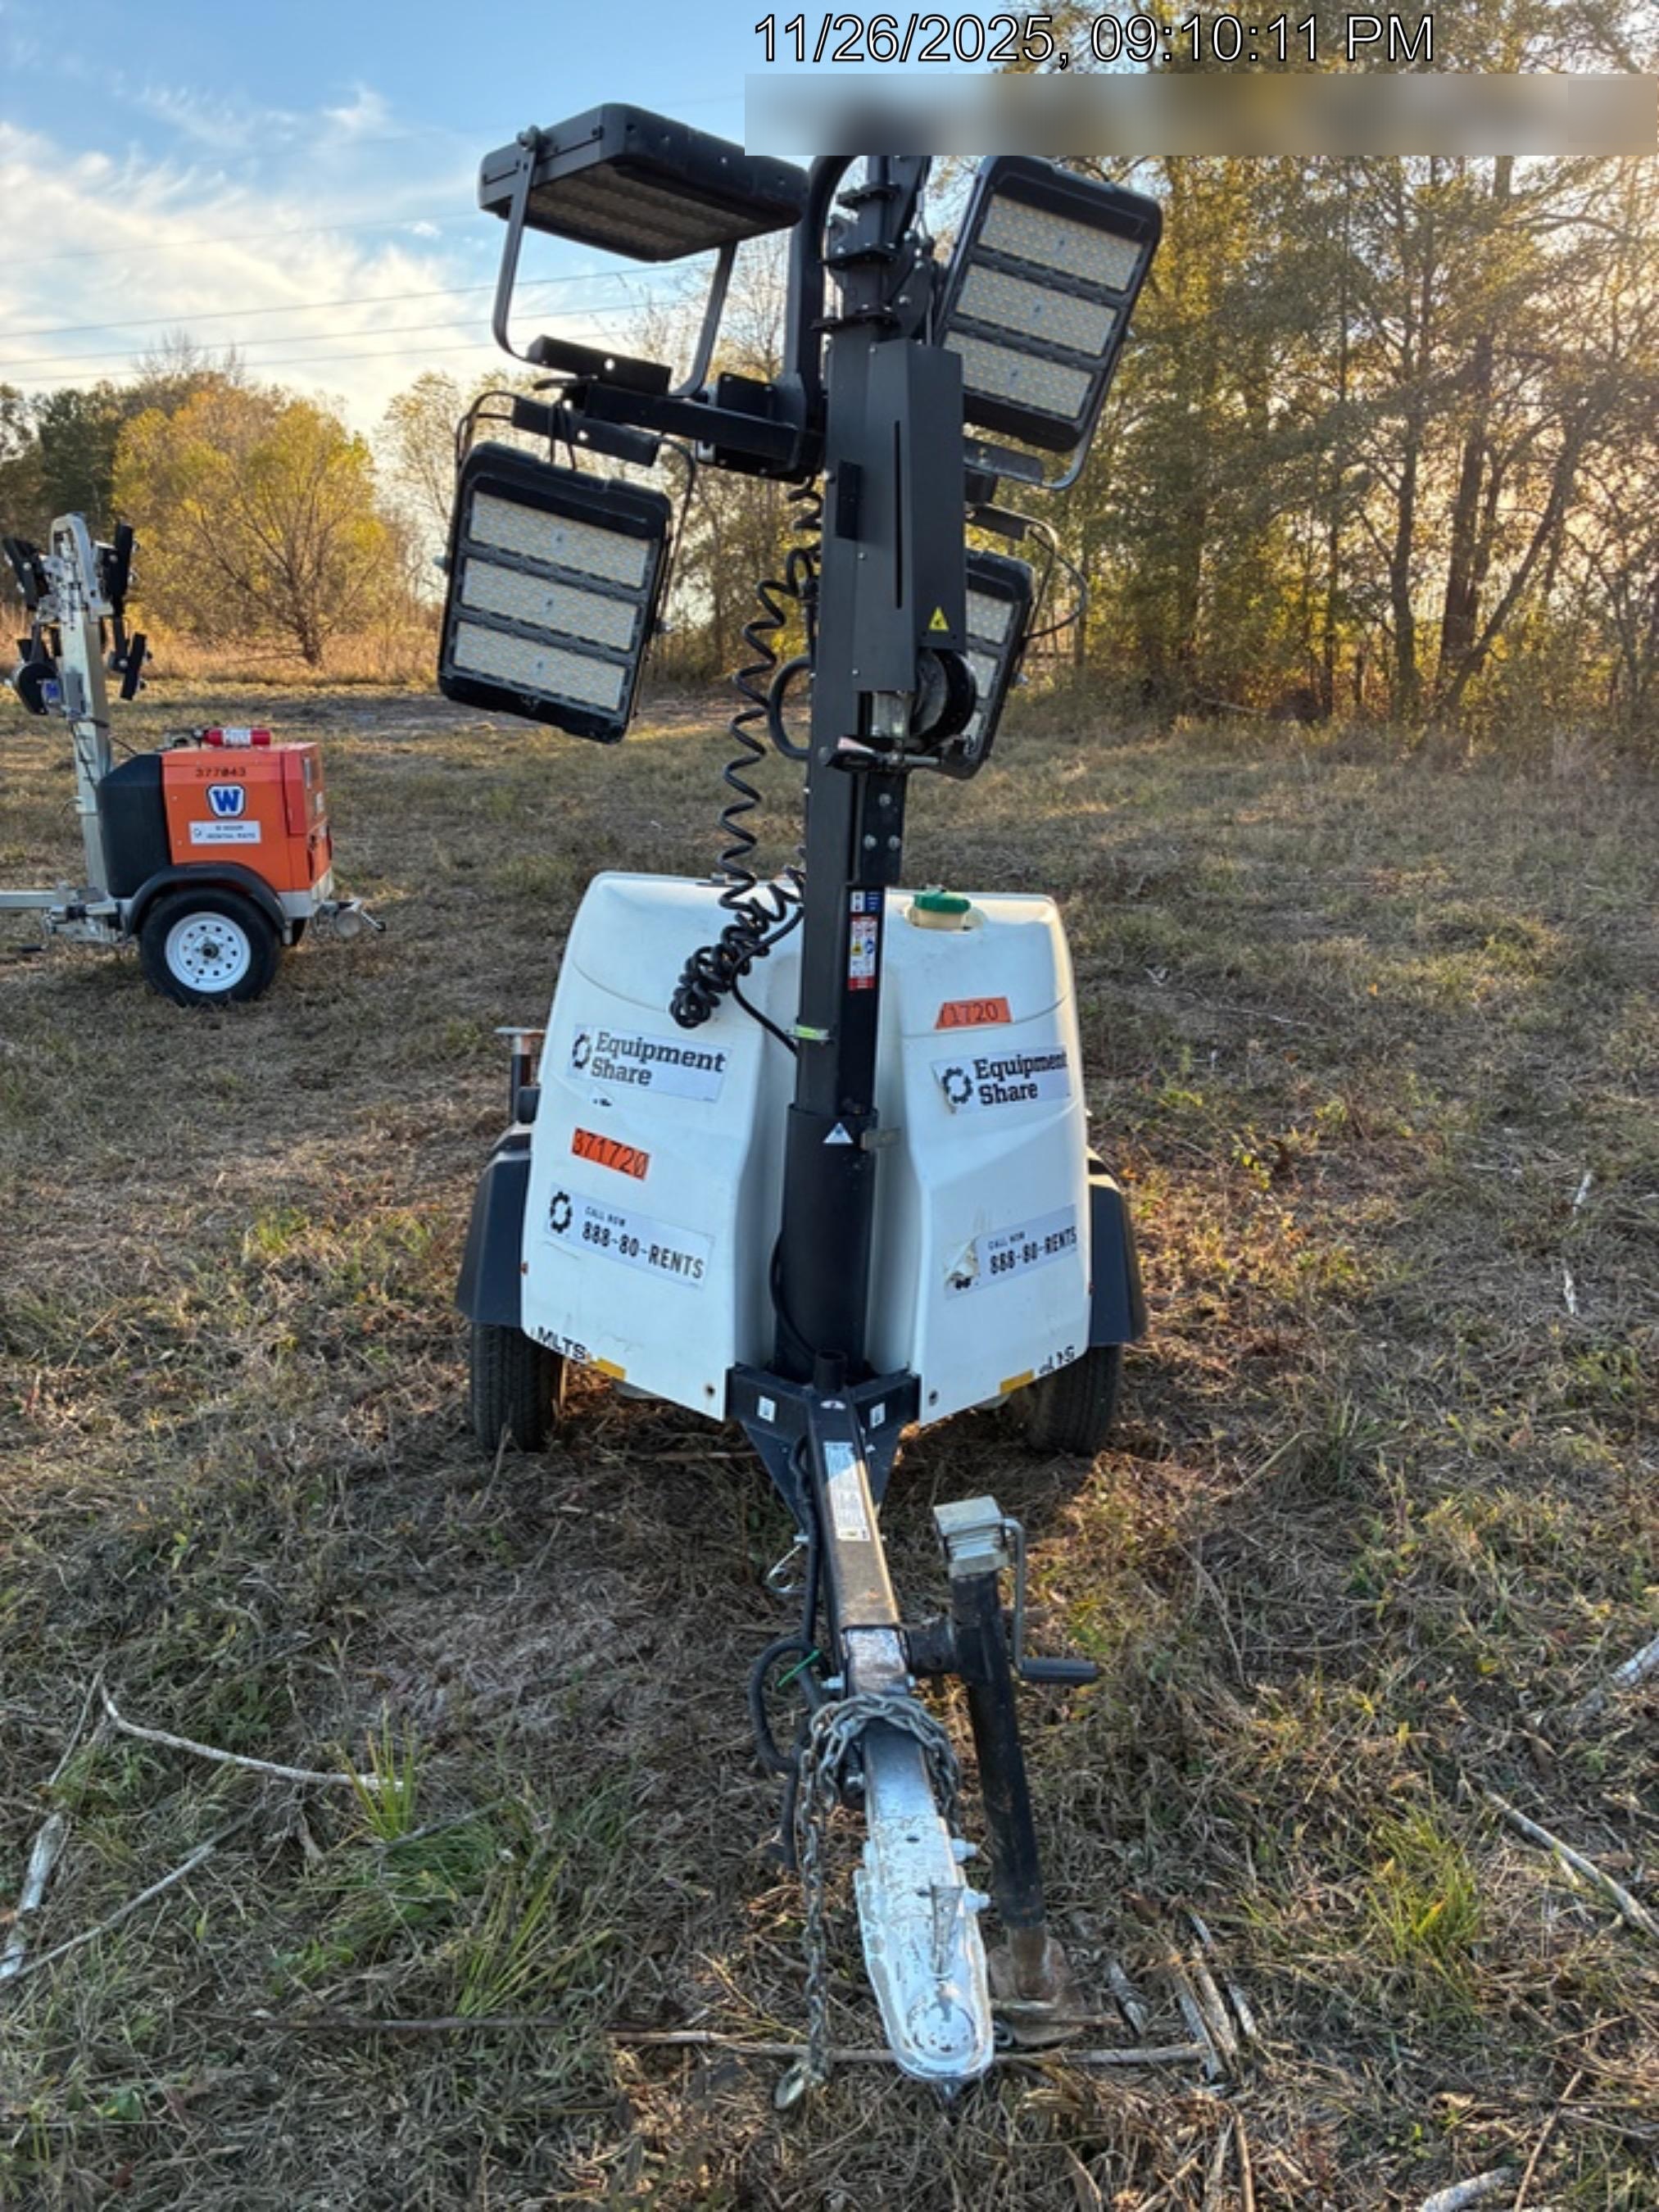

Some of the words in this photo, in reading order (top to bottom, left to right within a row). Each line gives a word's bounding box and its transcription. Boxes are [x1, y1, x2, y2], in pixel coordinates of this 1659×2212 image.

[211, 789, 241, 812] W
[596, 1031, 726, 1072] Equipment
[591, 1056, 652, 1087] Share
[977, 1082, 1039, 1106] Share
[582, 1221, 704, 1279] 888-80-RENTS
[990, 1226, 1077, 1275] 888-80-RENTS
